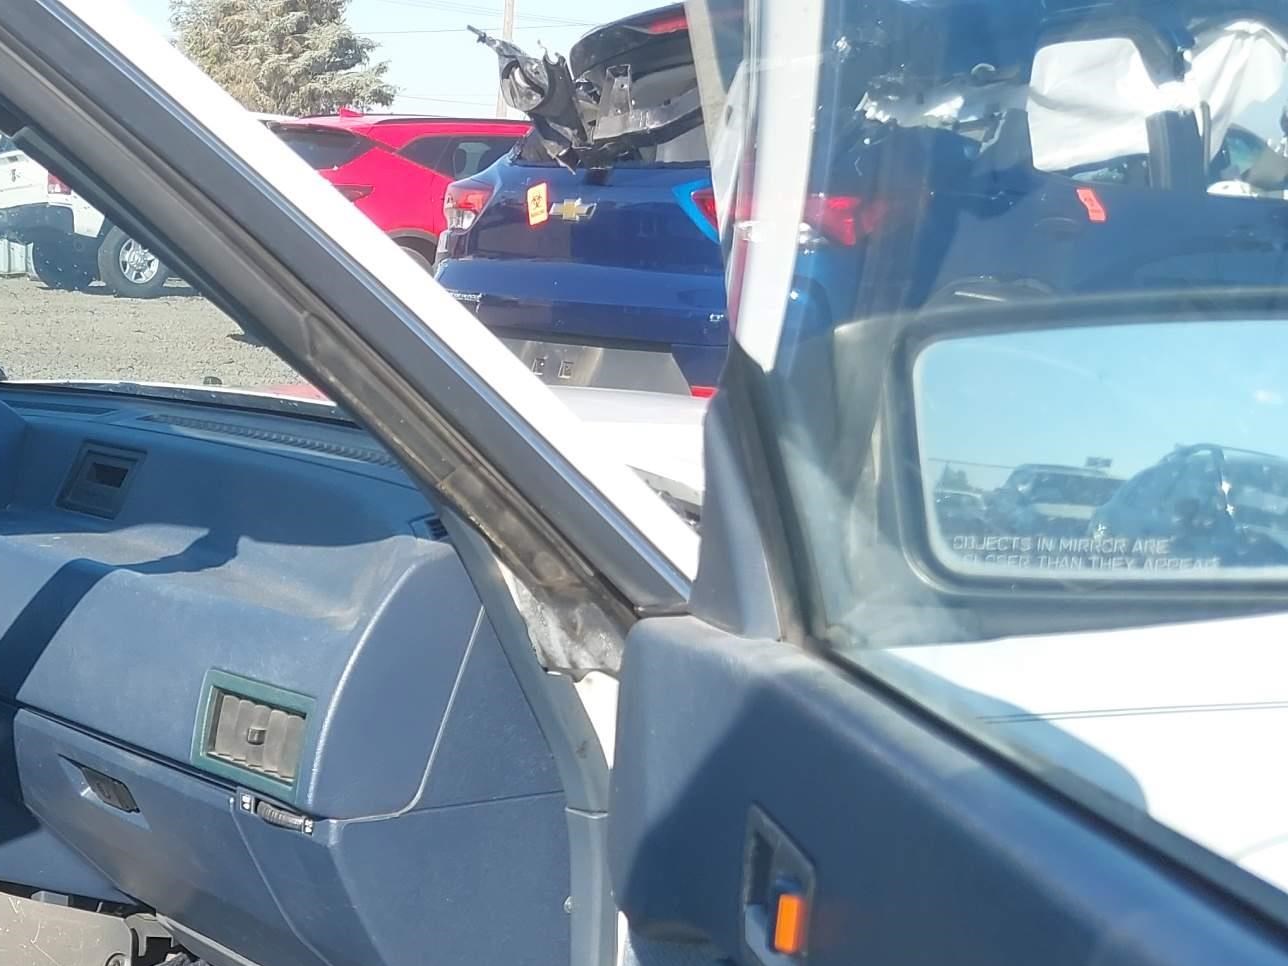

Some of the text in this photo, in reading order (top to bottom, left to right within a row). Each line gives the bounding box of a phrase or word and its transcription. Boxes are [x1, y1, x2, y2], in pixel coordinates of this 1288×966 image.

[952, 535, 1170, 554] OBJECTS IN MIRROR ARE
[1038, 555, 1083, 570] THAN
[1091, 556, 1134, 571] THEY
